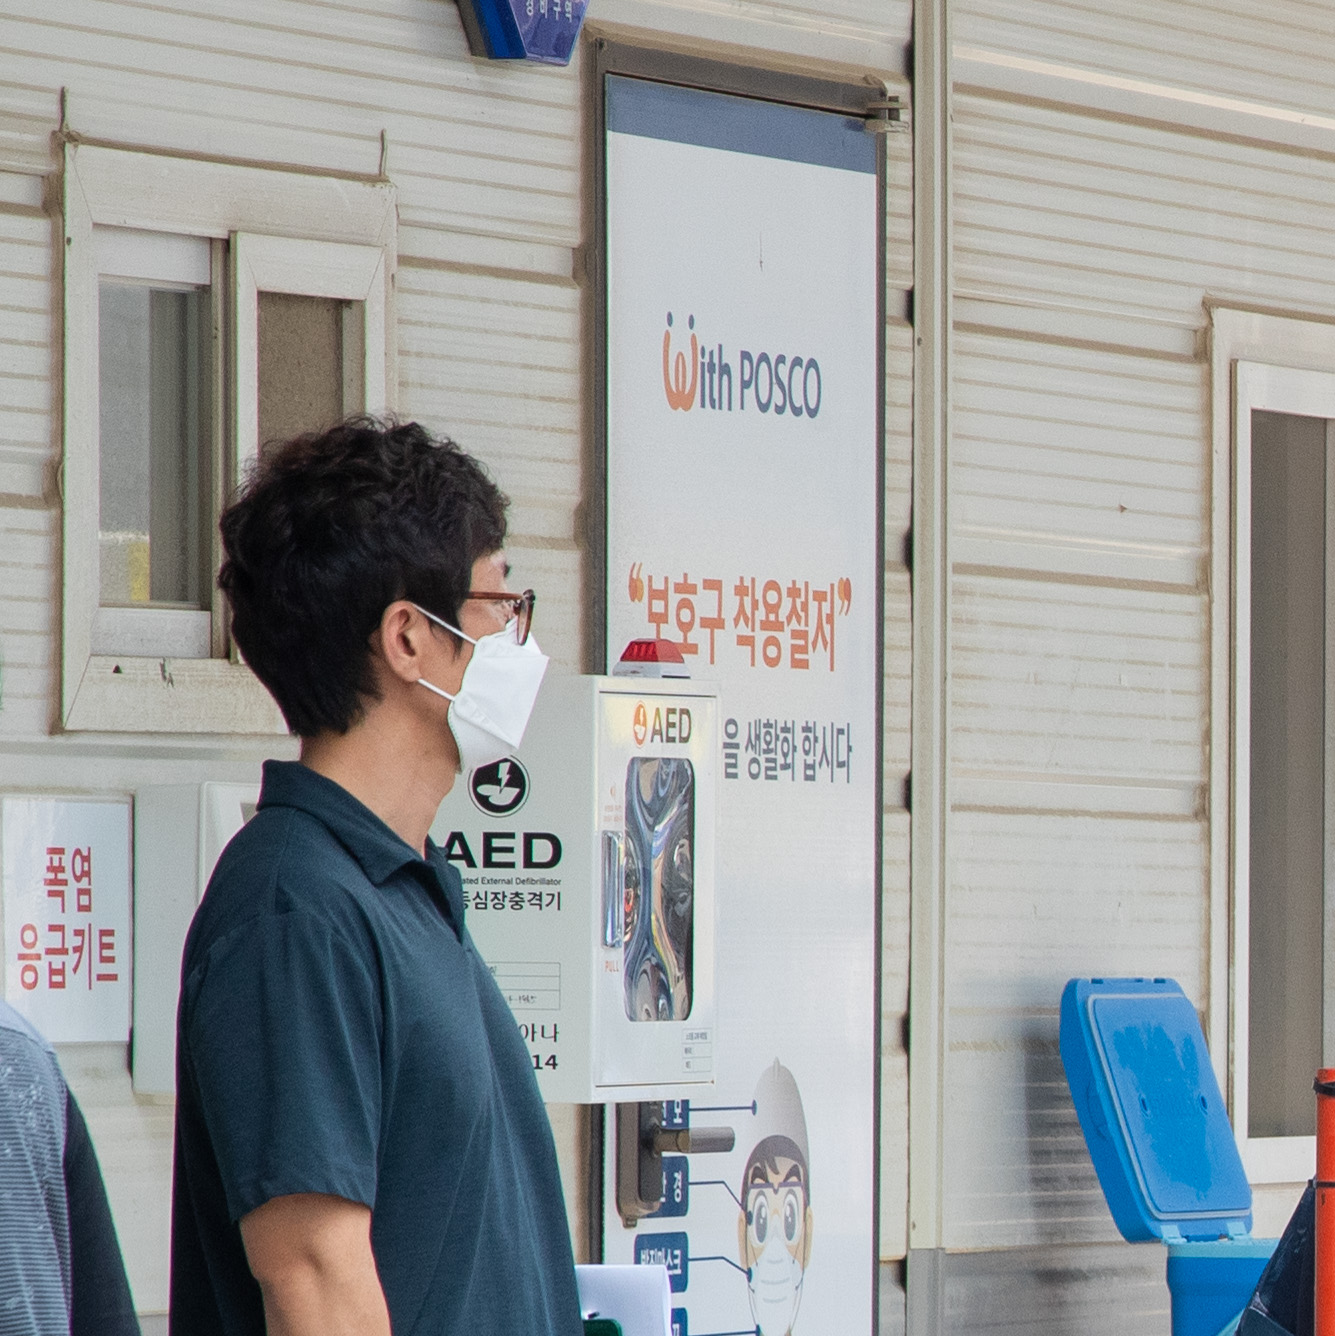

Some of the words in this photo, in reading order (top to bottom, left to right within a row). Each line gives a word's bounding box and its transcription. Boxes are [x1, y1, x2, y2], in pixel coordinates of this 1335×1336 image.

[739, 350, 822, 419] POSCO
[650, 707, 692, 744] AED
[745, 718, 798, 782] 생활화
[801, 719, 853, 784] 합시다
[44, 846, 93, 914] 폭염
[442, 831, 562, 869] AED
[481, 876, 513, 886] External
[515, 877, 562, 886] Defibrillator
[17, 922, 118, 991] 응급키트
